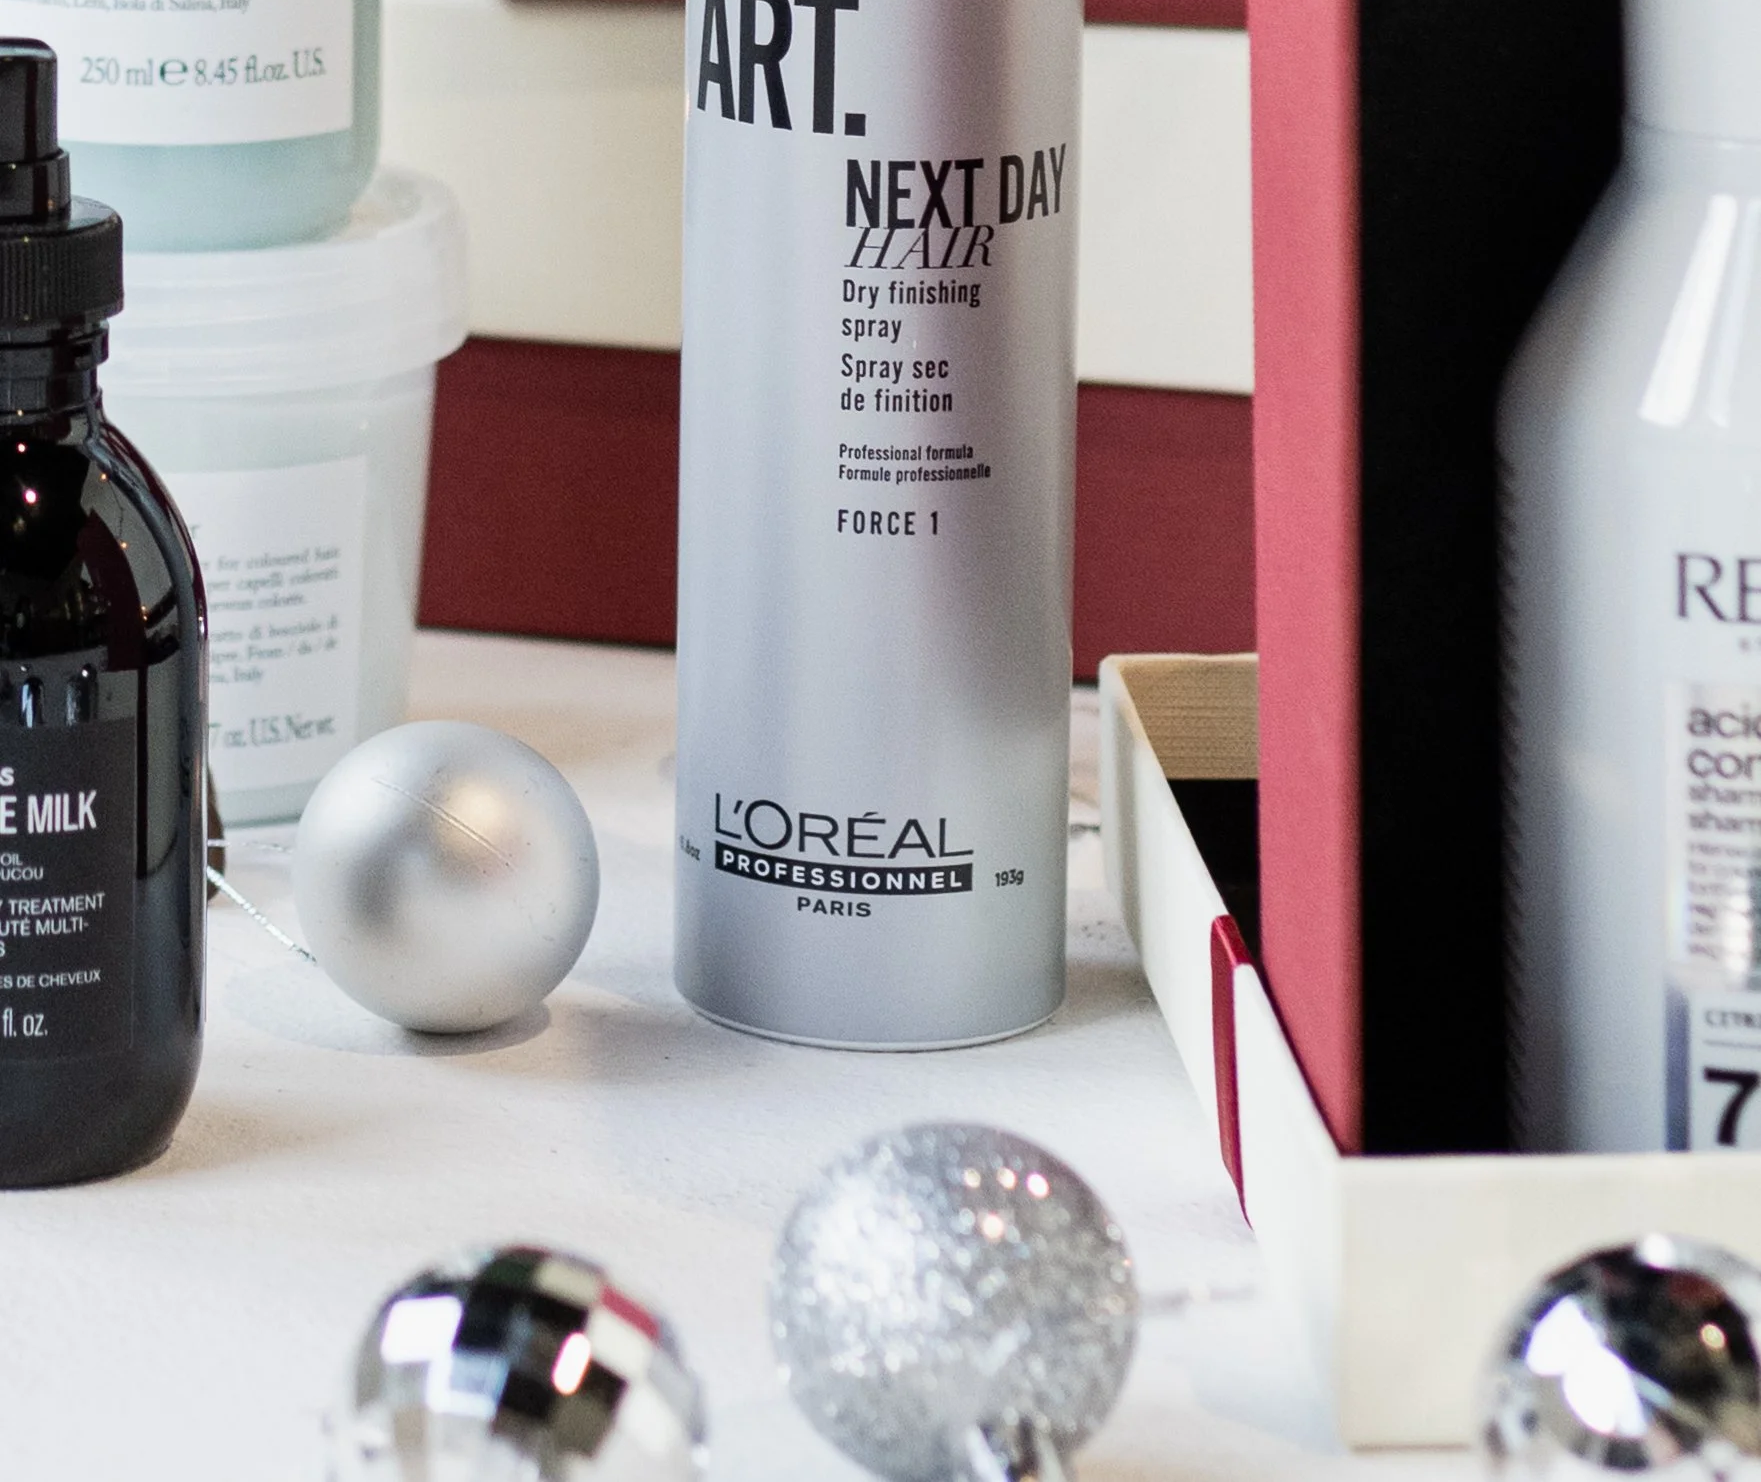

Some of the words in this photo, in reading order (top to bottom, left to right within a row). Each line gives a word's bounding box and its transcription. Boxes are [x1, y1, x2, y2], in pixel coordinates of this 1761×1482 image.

[80, 56, 120, 85] 250
[126, 58, 154, 86] ml
[194, 58, 237, 86] 8.45
[846, 158, 984, 229] NEXT
[999, 143, 1066, 224] DAY
[844, 224, 995, 269] HAIR
[842, 279, 879, 309] Dry
[889, 279, 981, 308] finishing
[841, 317, 902, 344] spray
[841, 353, 903, 384] Spray
[912, 359, 949, 379] sec
[841, 387, 865, 412] de
[874, 388, 953, 412] finition
[839, 443, 922, 461] Professional
[926, 444, 974, 461] formula
[839, 464, 891, 482] Formule
[896, 463, 991, 485] professionnelle
[837, 509, 916, 536] FORCE
[930, 511, 938, 536] 1
[27, 789, 98, 834] MILK
[715, 792, 974, 860] L'ORÉAL
[0, 853, 23, 866] OIL
[722, 849, 963, 893] PROFESSIONNEL
[0, 867, 44, 881] UCOU
[994, 869, 1024, 887] 193g
[9, 891, 105, 915] TREATMENT
[797, 896, 872, 918] PARIS
[35, 916, 89, 936] MULTI-
[17, 975, 35, 989] DE
[38, 969, 101, 988] CHEVEUX
[22, 1013, 49, 1037] oz.
[1704, 1067, 1761, 1147] 7
